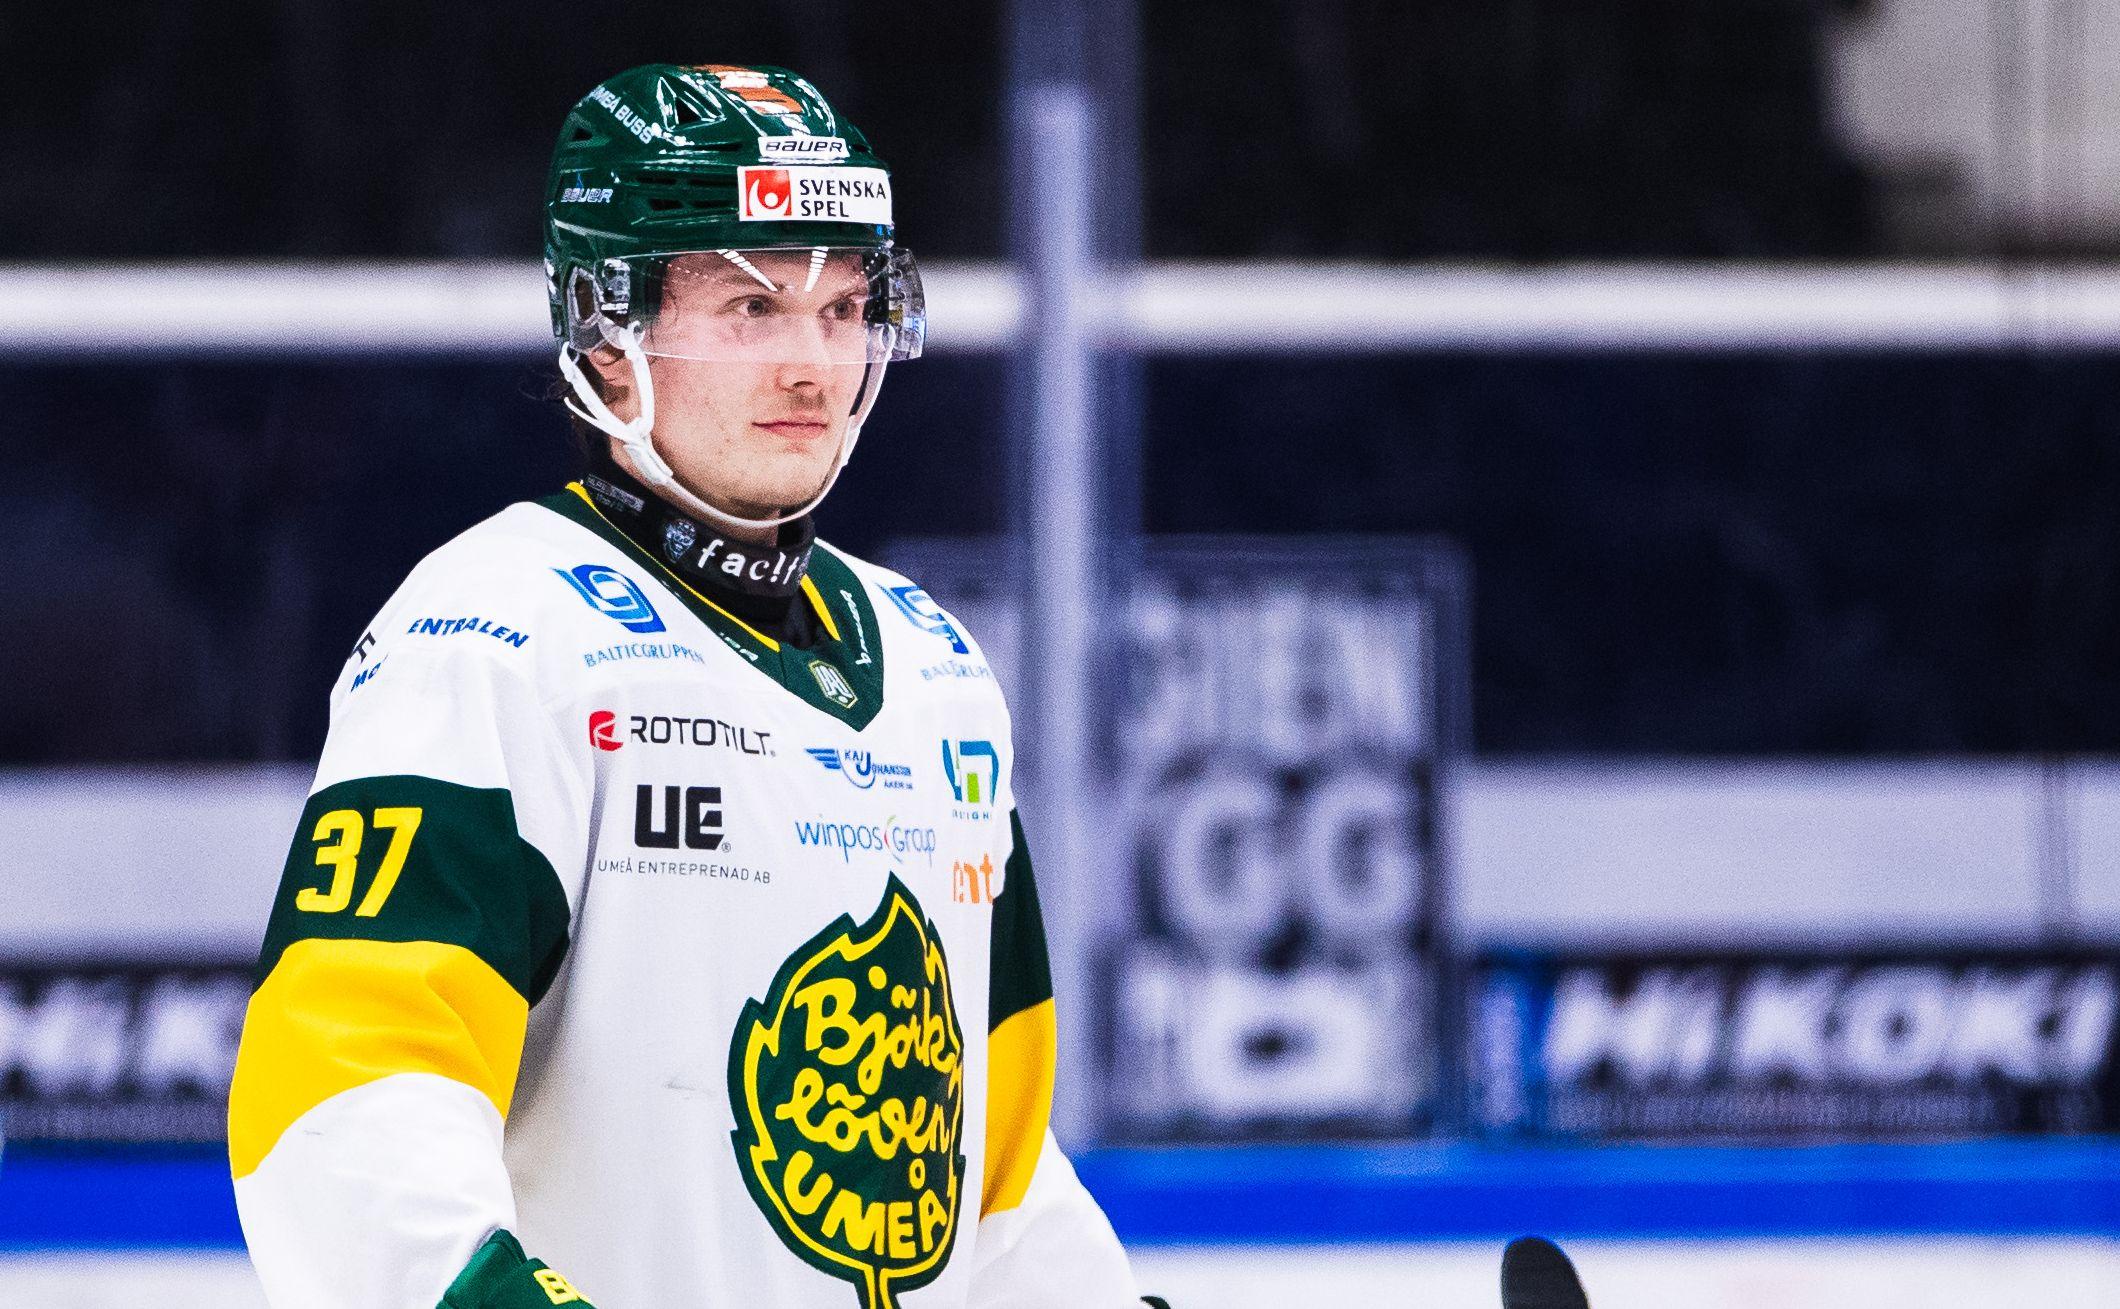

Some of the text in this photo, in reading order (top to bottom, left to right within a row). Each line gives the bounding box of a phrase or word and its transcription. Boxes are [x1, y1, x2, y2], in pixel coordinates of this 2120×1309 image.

[614, 104, 653, 145] BUSS
[765, 139, 843, 153] BAUER
[799, 178, 887, 199] SVENSKA
[800, 200, 850, 218] SPEL
[630, 716, 771, 756] ROTOTILT
[634, 784, 725, 851] UE
[295, 807, 423, 917] 37
[599, 857, 771, 884] UMEÅ ENTREPRENAD AB
[783, 1150, 947, 1260] UMEÅ
